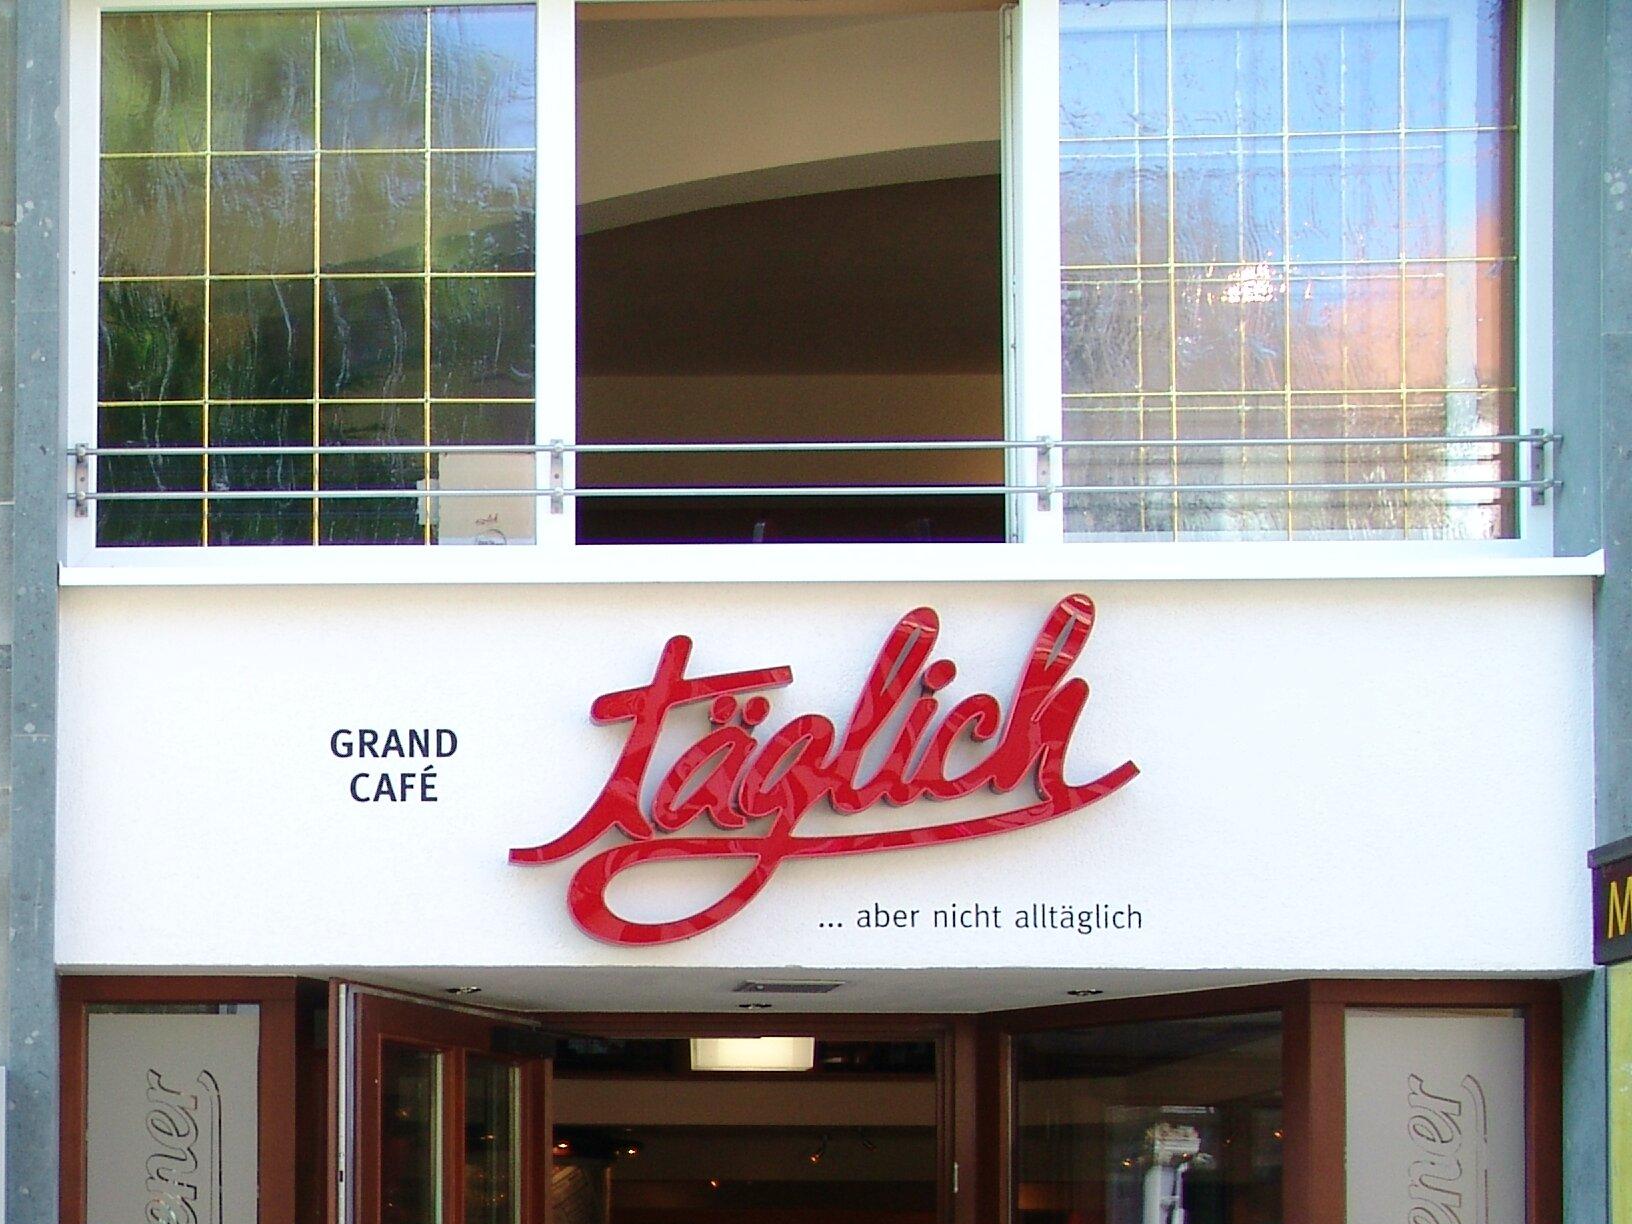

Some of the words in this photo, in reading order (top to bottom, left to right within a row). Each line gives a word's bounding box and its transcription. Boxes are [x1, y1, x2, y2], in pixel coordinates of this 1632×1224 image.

[330, 728, 458, 758] GRAND
[350, 764, 438, 802] CAFÉ
[508, 592, 1140, 945] täglich
[856, 902, 920, 929] aber
[933, 903, 1002, 929] nicht
[1014, 903, 1143, 935] alltäglich
